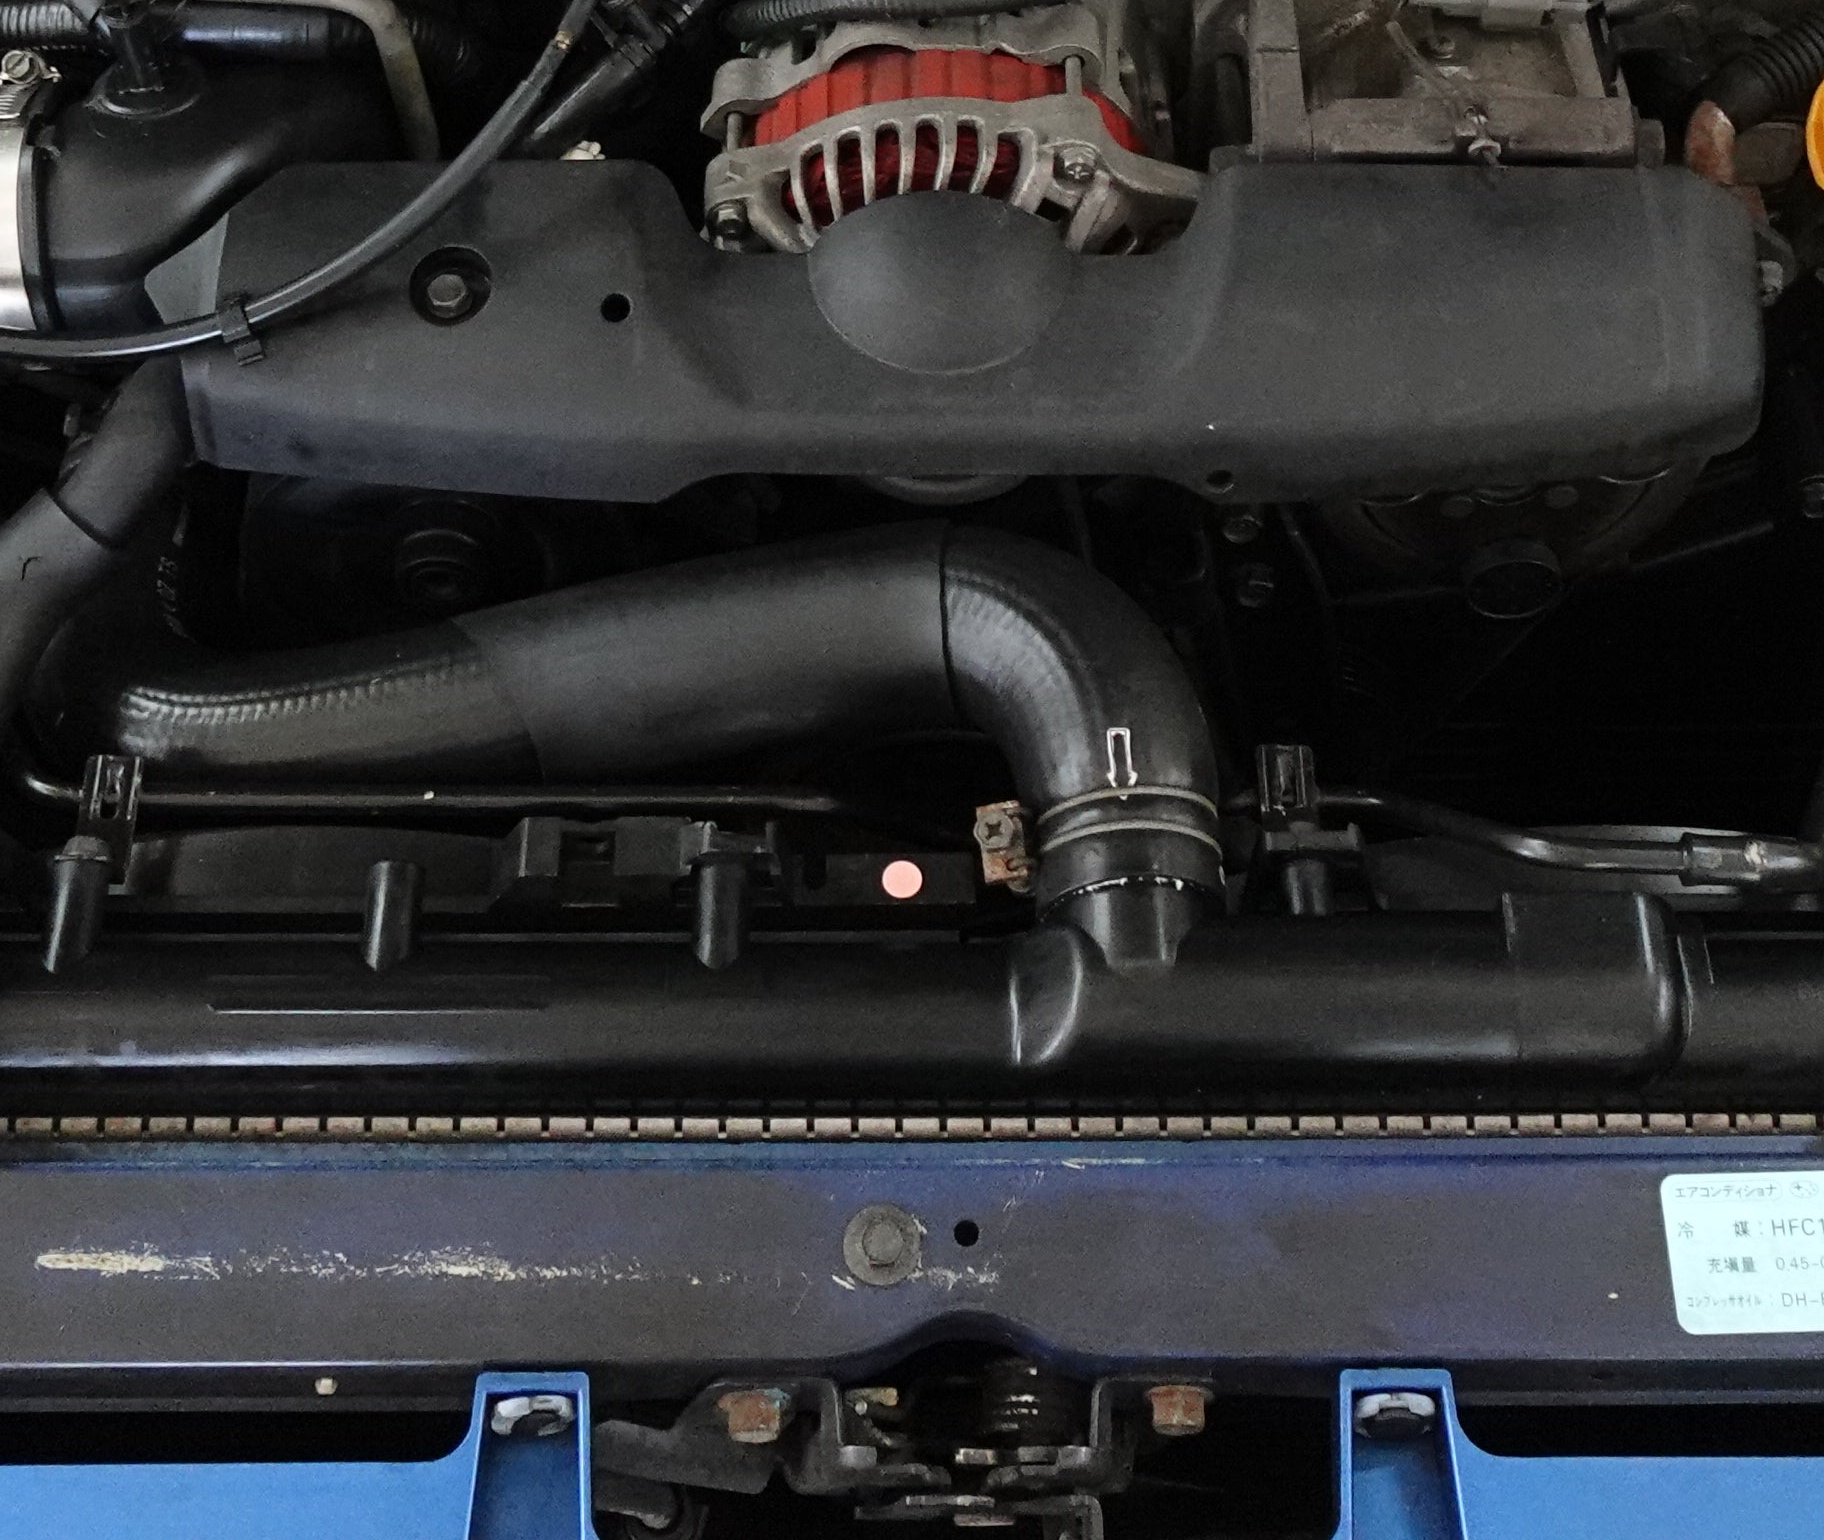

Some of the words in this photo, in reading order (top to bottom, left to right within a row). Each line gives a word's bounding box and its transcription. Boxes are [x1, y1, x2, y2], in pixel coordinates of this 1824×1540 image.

[1675, 1183, 1778, 1199] エアコンディショナ
